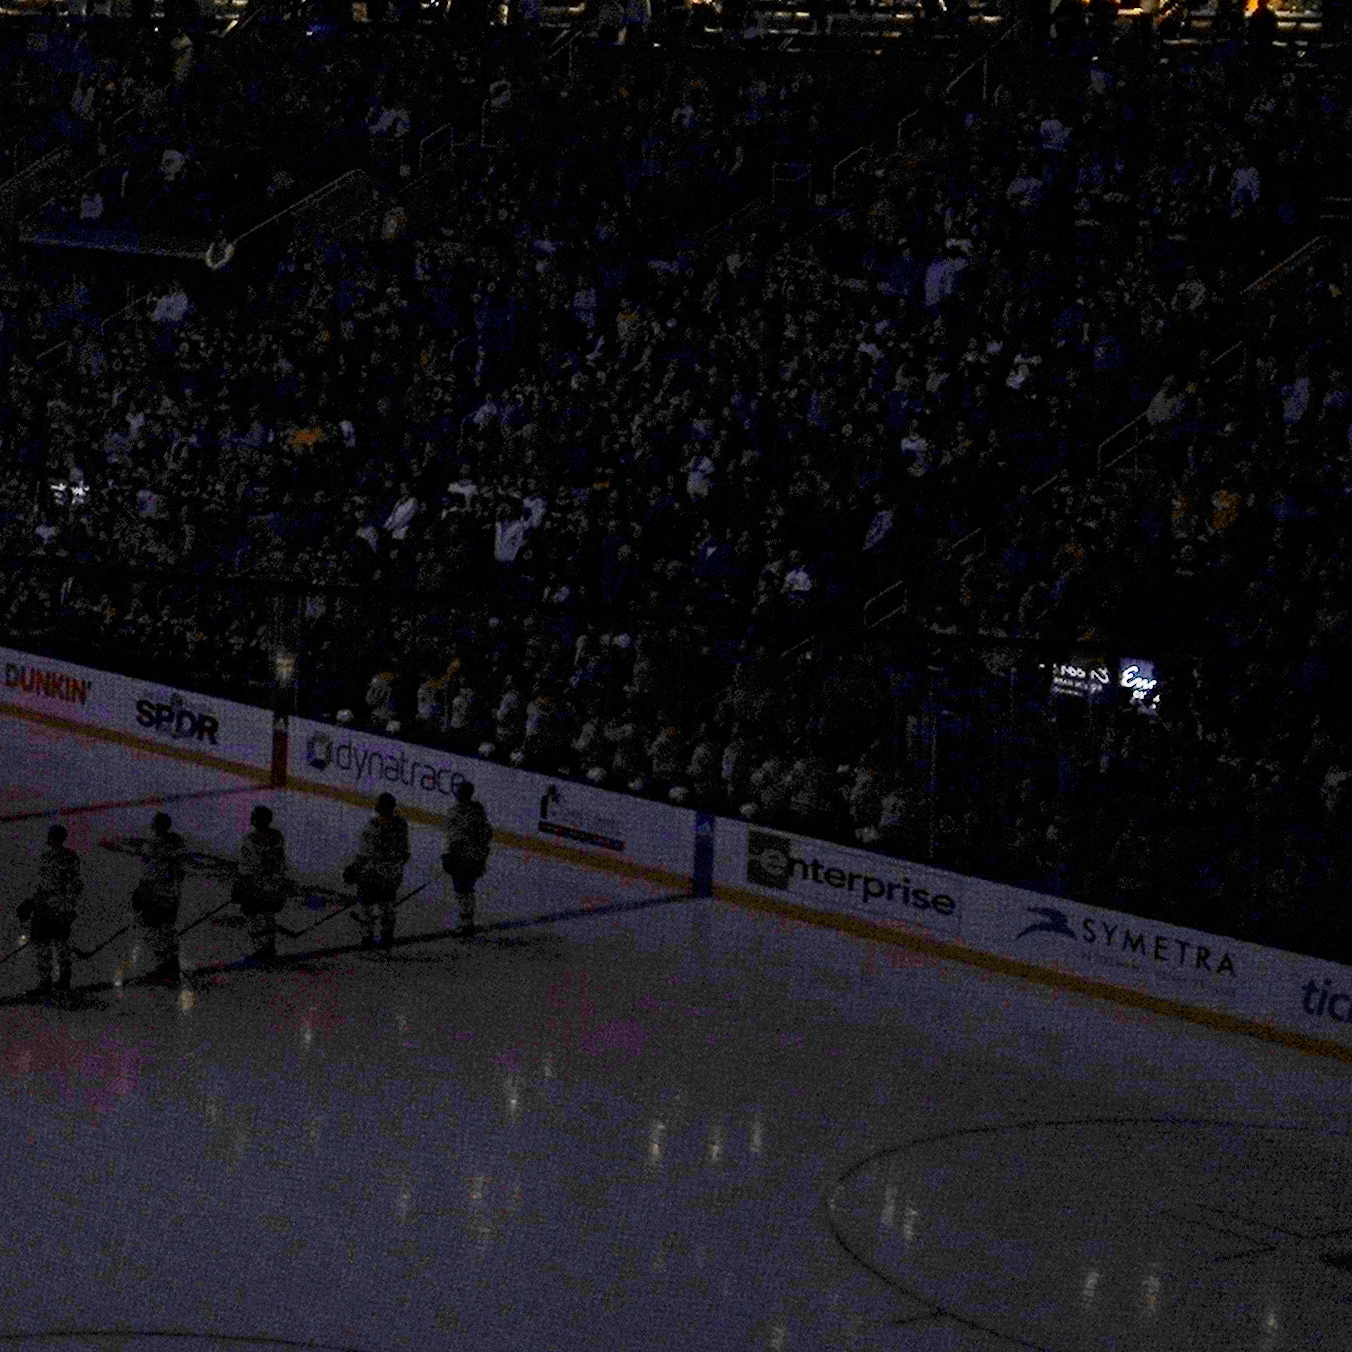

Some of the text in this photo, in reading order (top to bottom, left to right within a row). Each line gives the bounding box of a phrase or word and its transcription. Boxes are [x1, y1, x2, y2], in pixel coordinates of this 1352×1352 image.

[4, 662, 93, 705] DUNKIN'
[136, 697, 221, 746] SPDR
[336, 736, 466, 797] dynatrace
[758, 846, 957, 916] enterprise
[1081, 917, 1238, 978] SYMETRA
[1300, 976, 1352, 1022] tic
